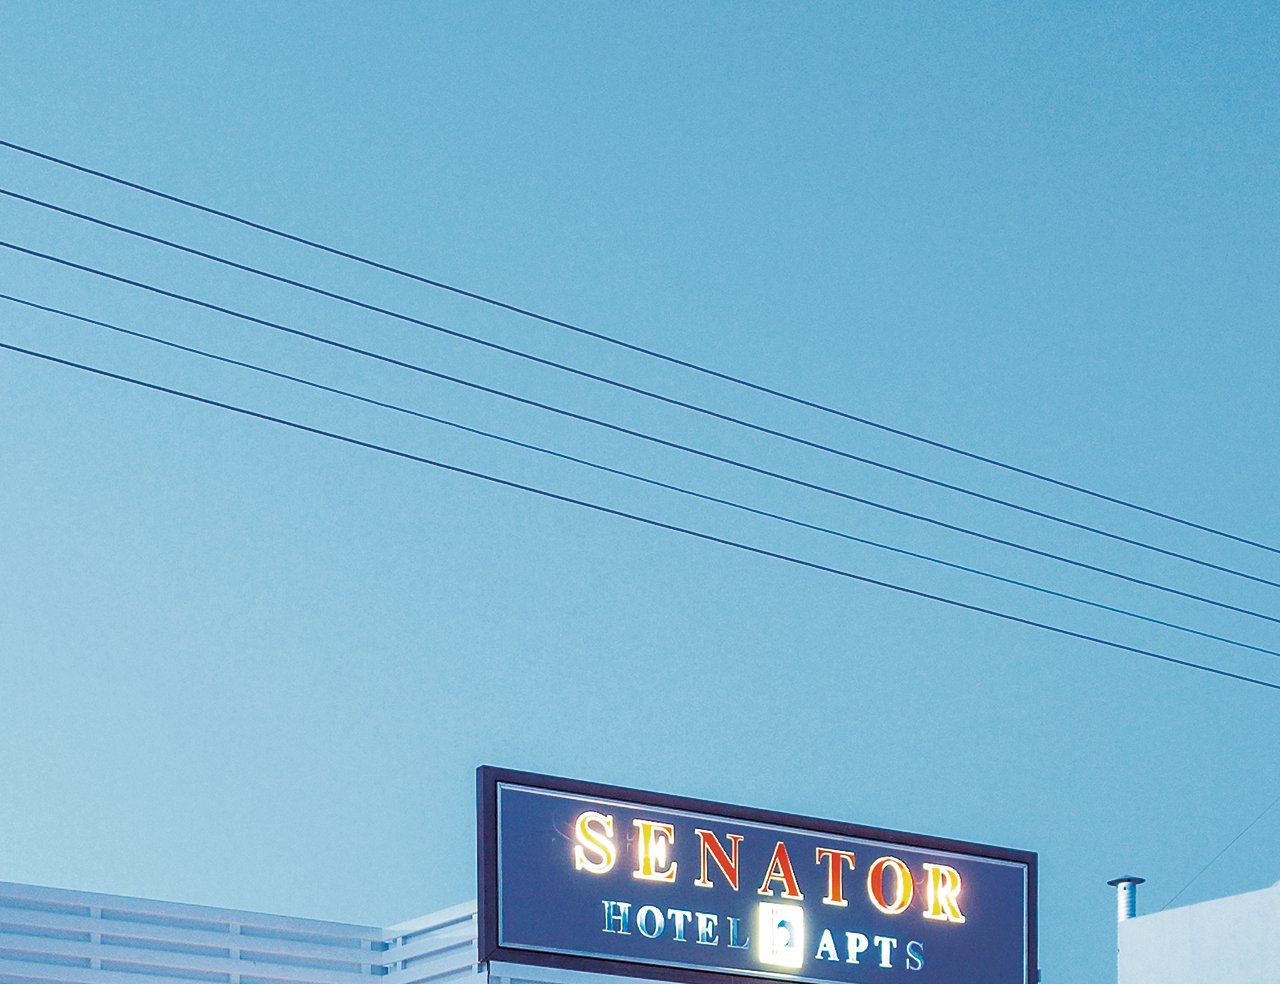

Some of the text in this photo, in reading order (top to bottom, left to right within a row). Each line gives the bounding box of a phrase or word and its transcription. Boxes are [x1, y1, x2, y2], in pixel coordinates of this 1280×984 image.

[574, 810, 966, 923] SENATOR
[602, 900, 925, 971] HOTEL APTS
